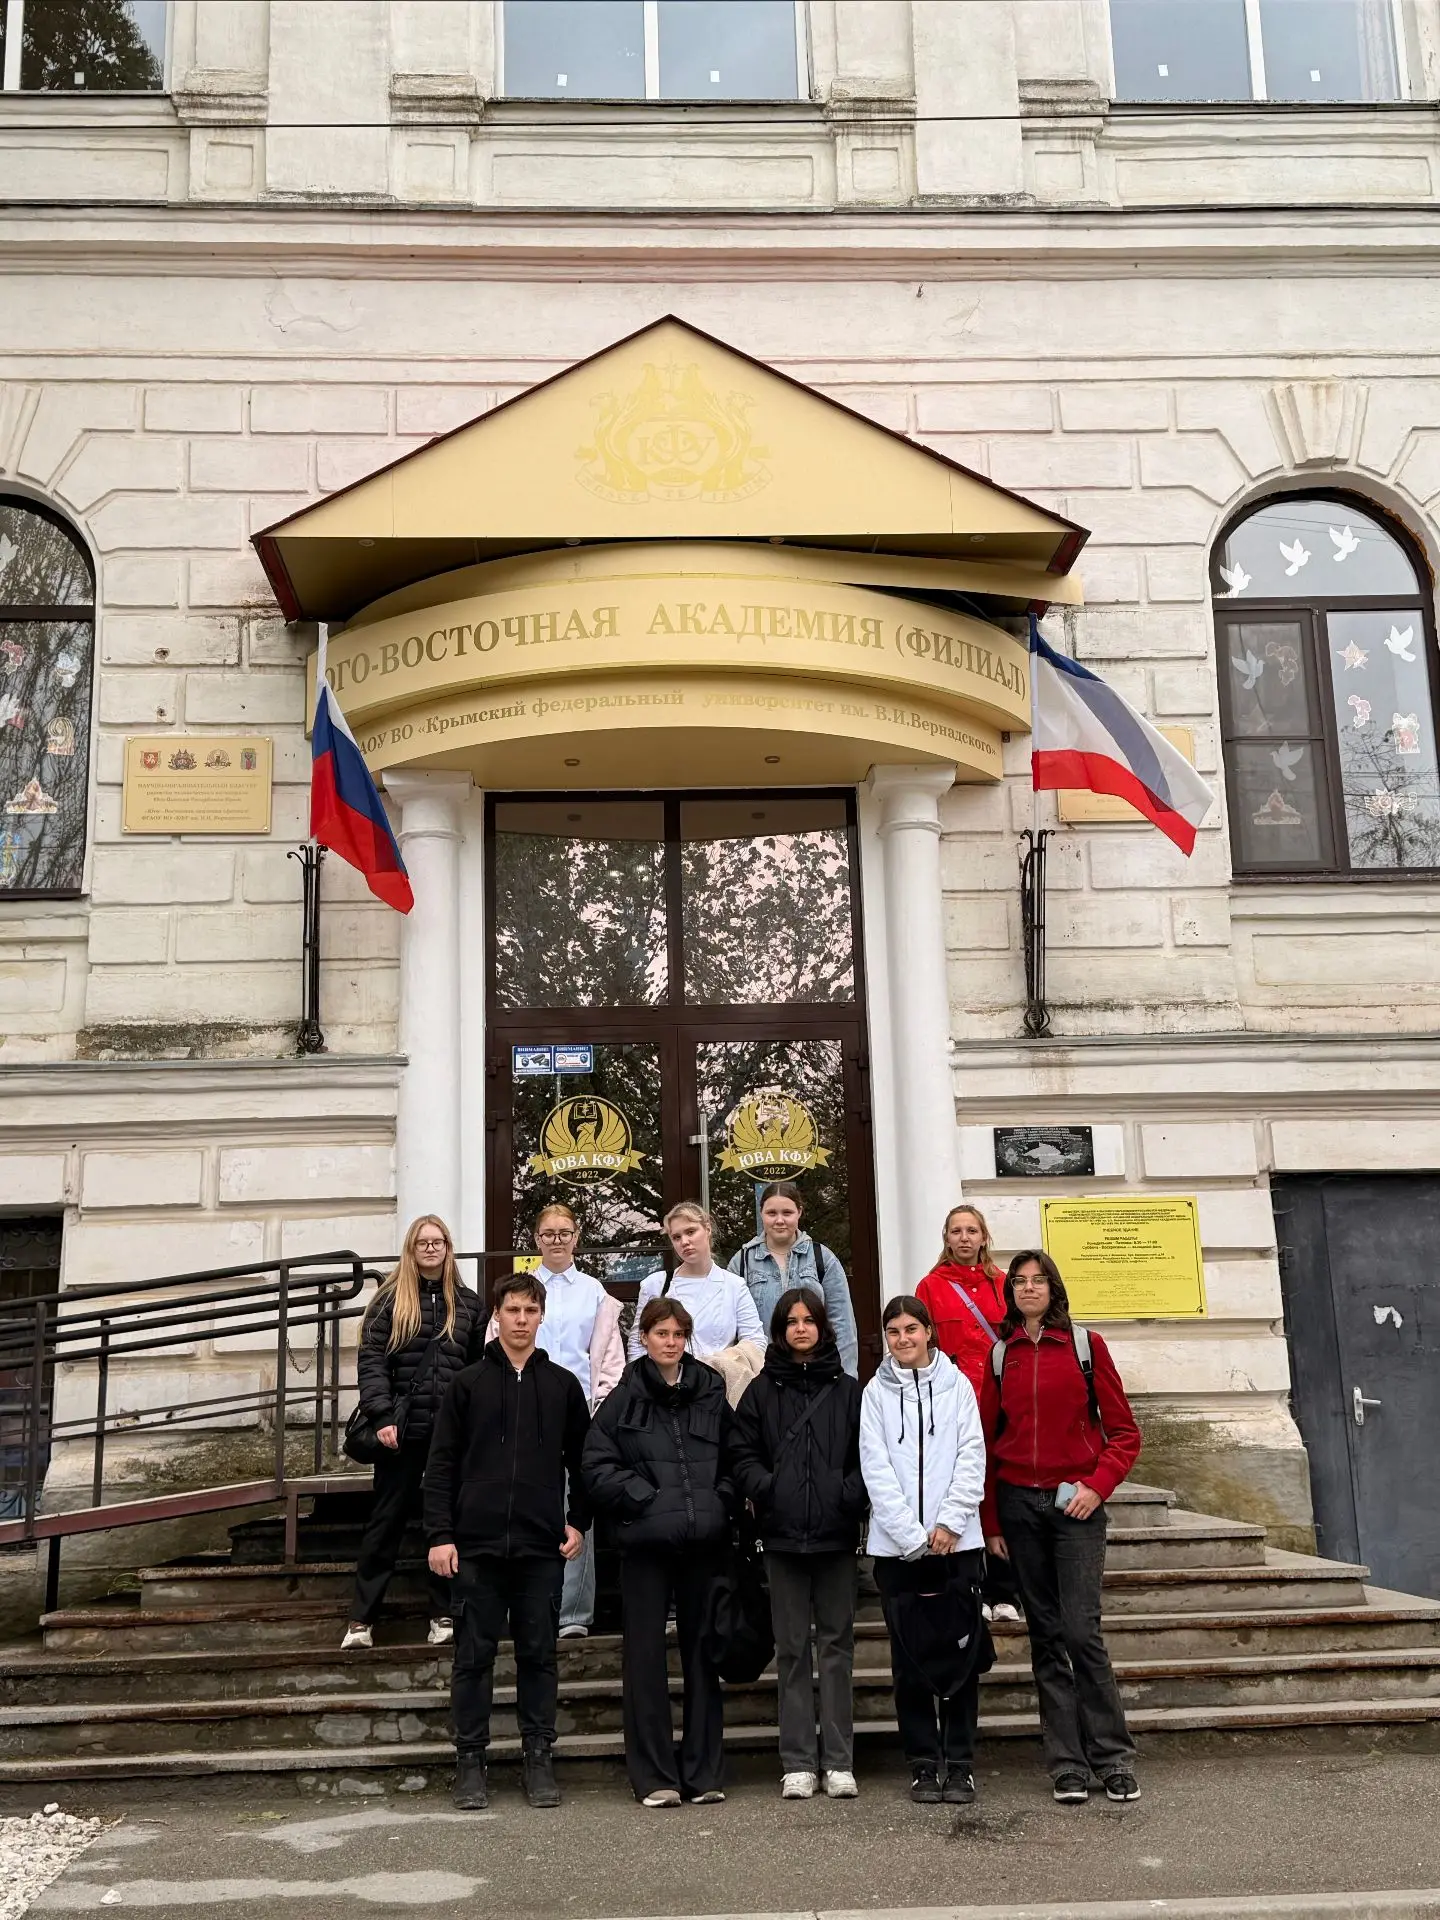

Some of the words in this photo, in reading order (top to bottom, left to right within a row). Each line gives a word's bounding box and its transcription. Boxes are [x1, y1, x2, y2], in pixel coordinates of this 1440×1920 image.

[646, 602, 885, 650] АКАДЕМИЯ
[894, 623, 1026, 701] (ФИЛИАЛ)
[390, 723, 414, 745] ВО
[417, 700, 527, 737] «Крымский
[531, 687, 684, 716] федеральный
[839, 704, 870, 718] им.
[550, 1154, 588, 1172] ЮВА
[592, 1154, 626, 1168] КФУ
[738, 1150, 775, 1168] ЮВА
[779, 1149, 812, 1163] КФУ
[575, 1170, 599, 1179] 2022
[763, 1167, 787, 1175] 2022
